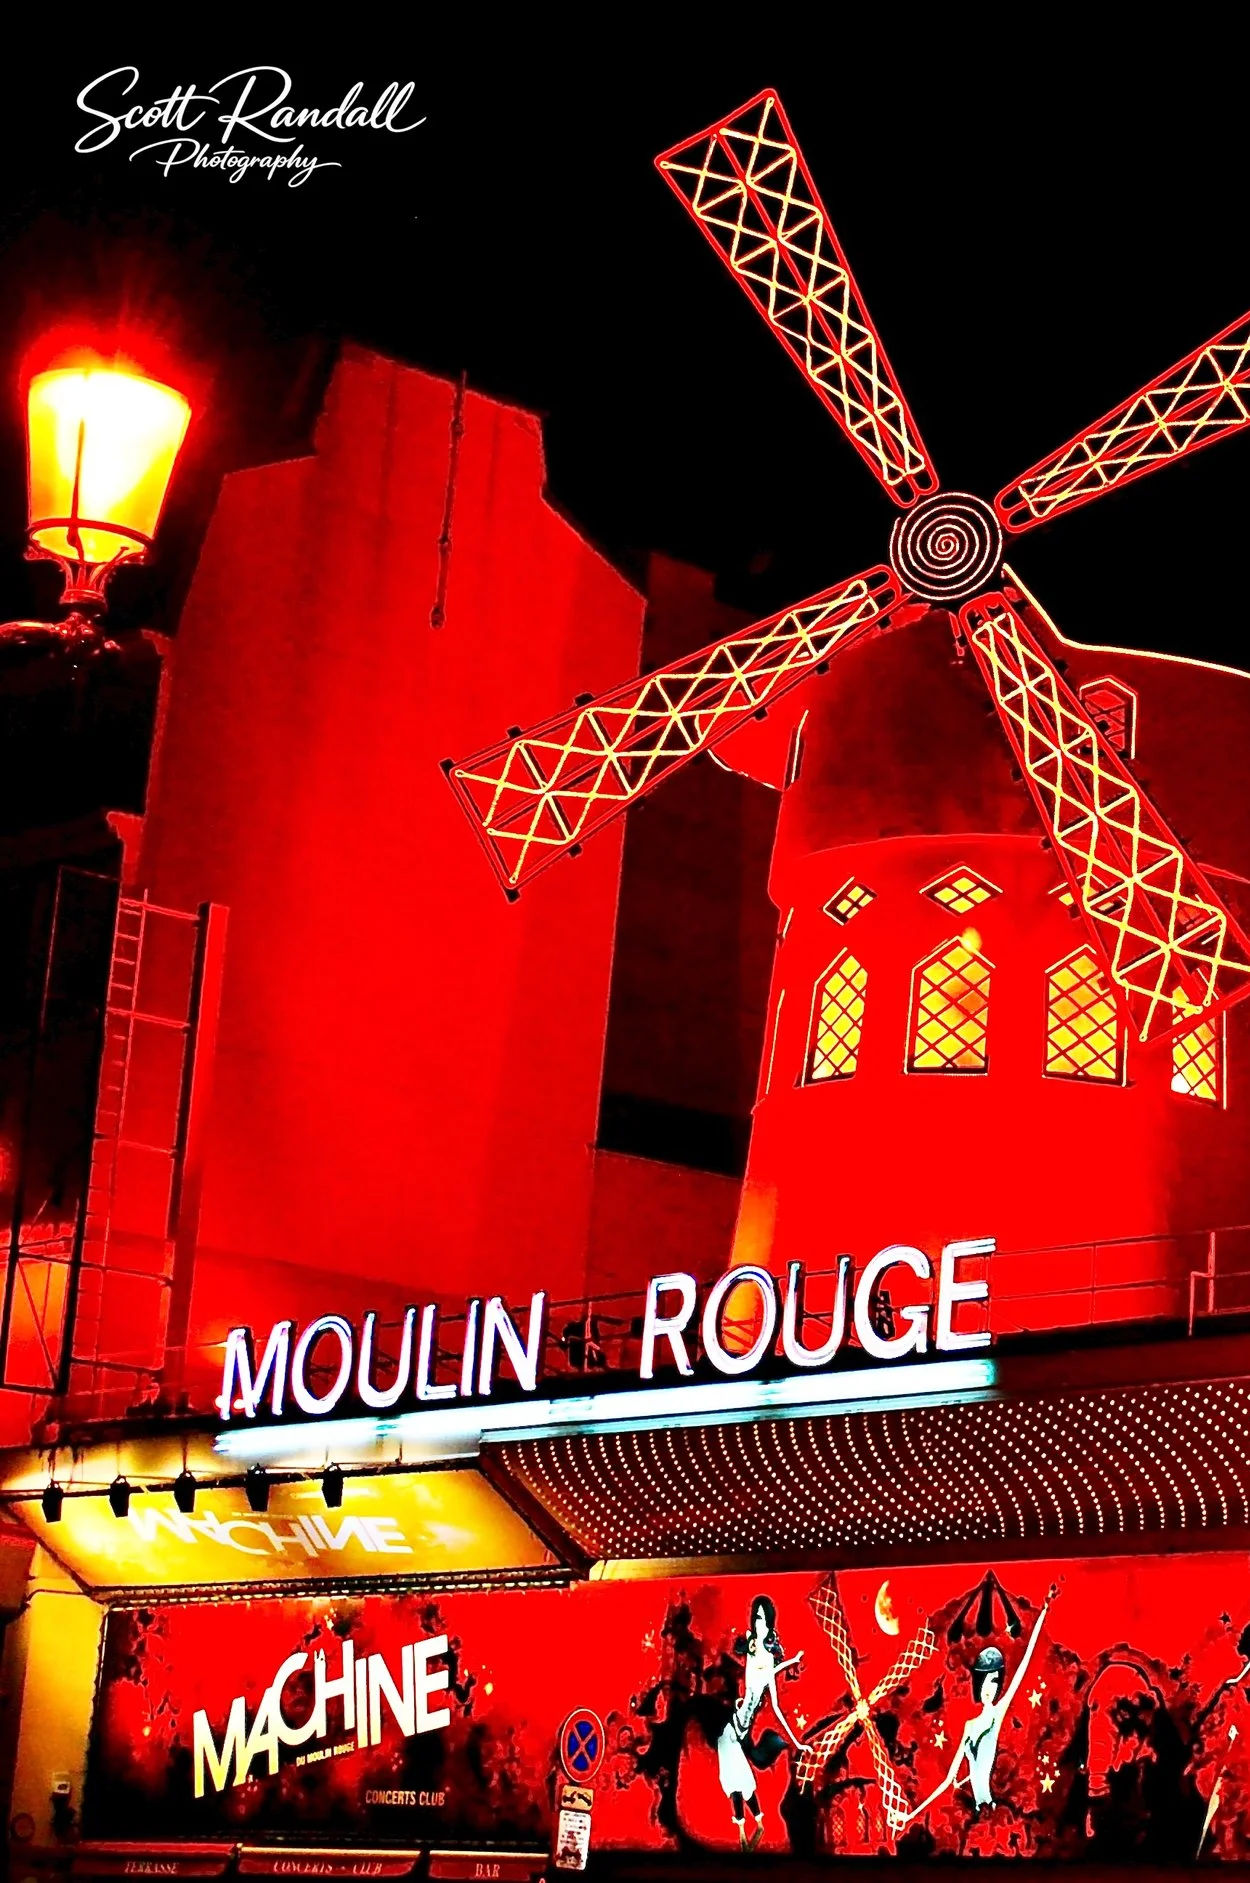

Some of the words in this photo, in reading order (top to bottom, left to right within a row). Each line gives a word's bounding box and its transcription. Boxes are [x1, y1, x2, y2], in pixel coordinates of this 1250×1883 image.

[216, 1289, 546, 1420] MOULIN
[639, 1237, 996, 1380] ROUGE
[193, 1634, 450, 1798] MACHINE
[365, 1789, 416, 1805] CONCERTS
[419, 1790, 445, 1806] CLUB
[475, 1863, 501, 1878] BAR
